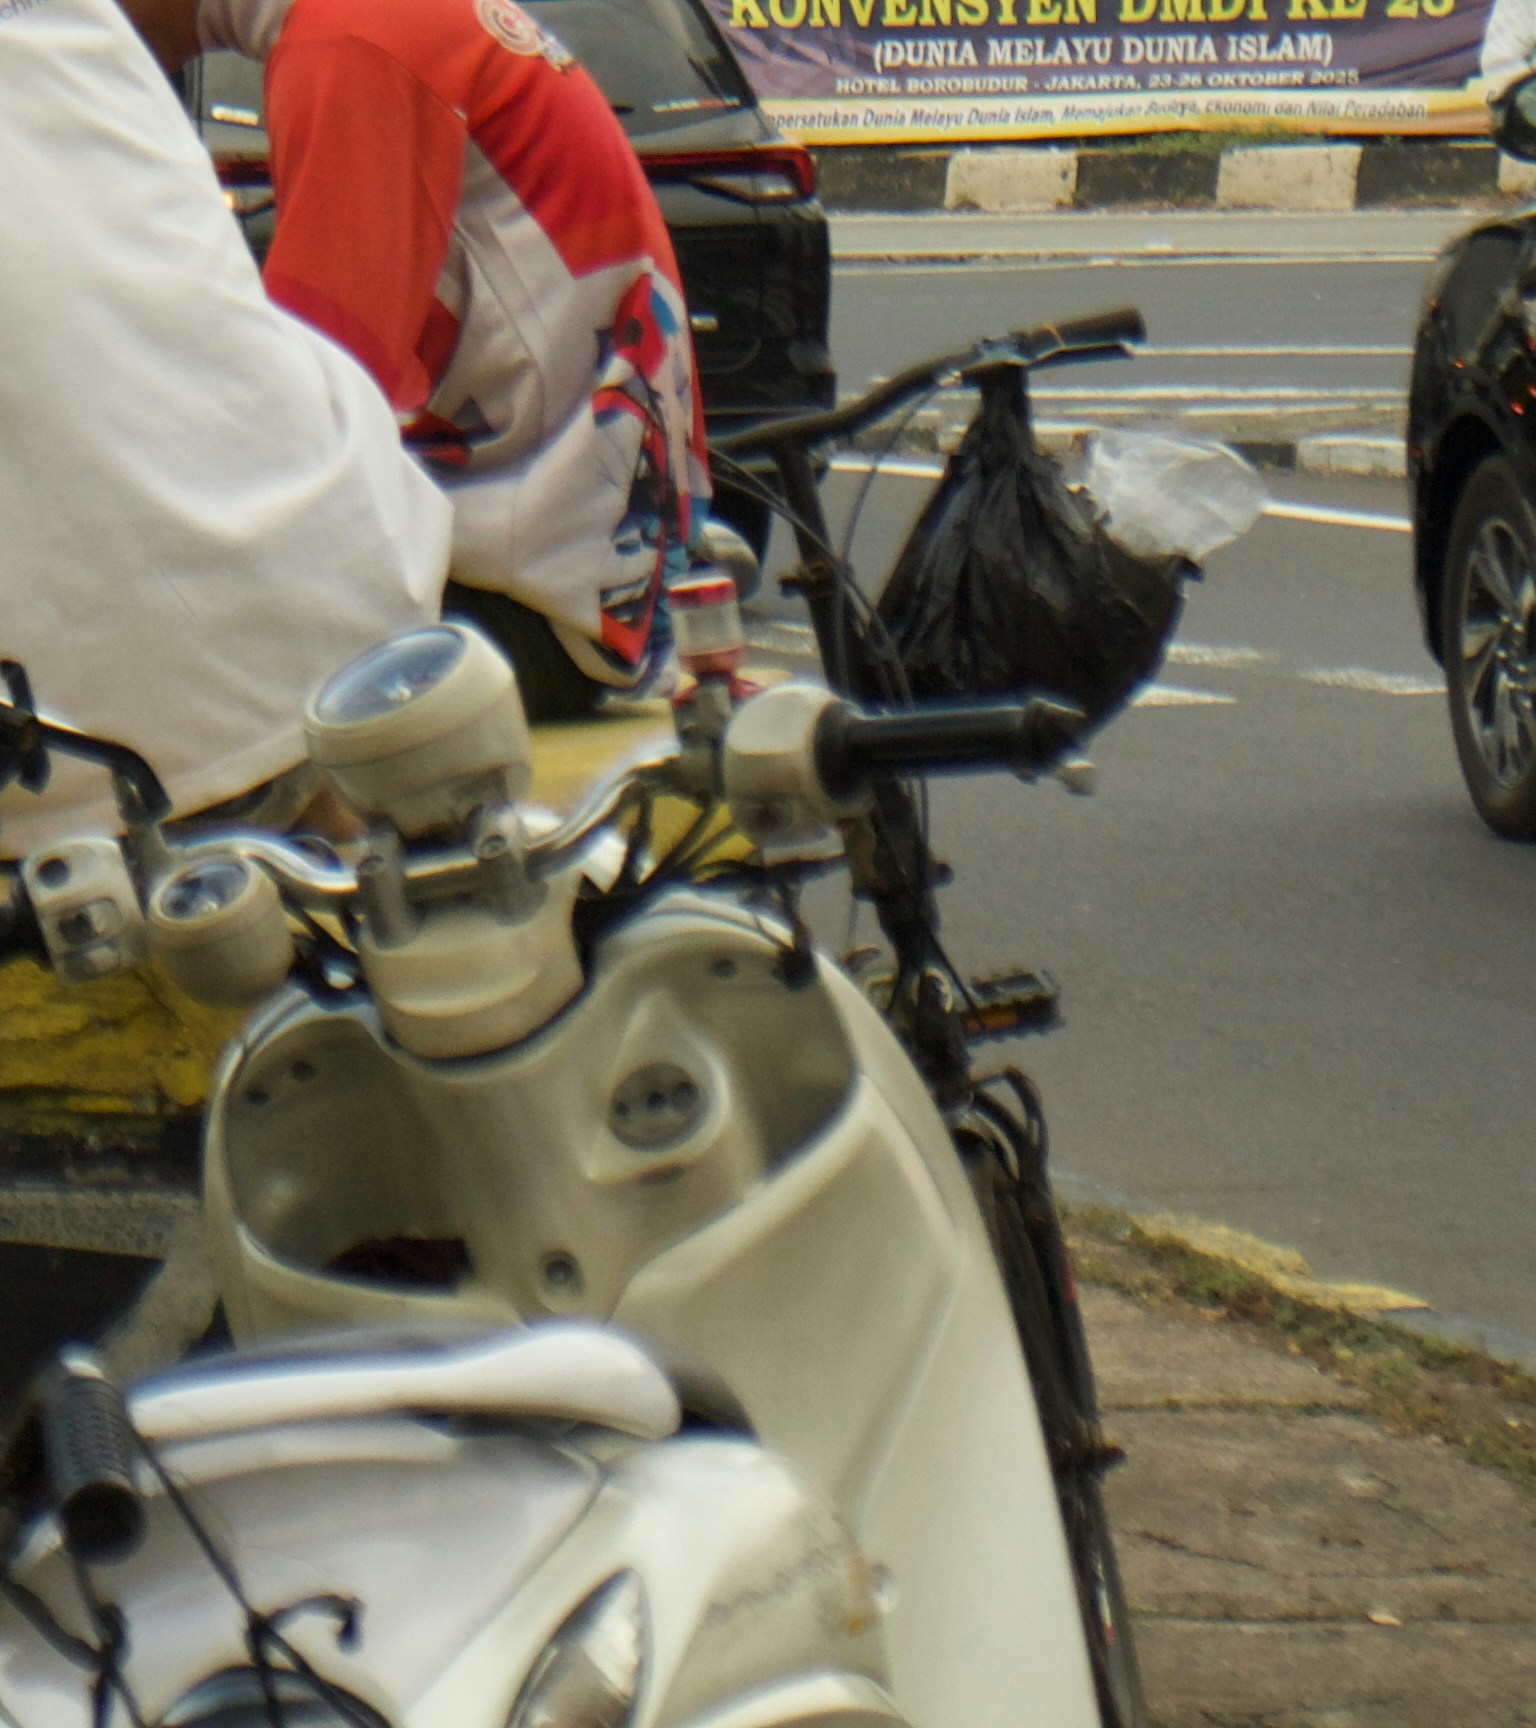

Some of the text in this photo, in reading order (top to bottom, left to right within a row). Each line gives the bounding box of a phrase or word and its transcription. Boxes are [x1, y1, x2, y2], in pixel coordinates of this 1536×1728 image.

[872, 31, 1334, 74] (DUNIA MELAYU DUNIA ISLAM)
[835, 77, 902, 95] HOTEL
[906, 75, 1029, 93] BOROBUDUR
[1206, 69, 1306, 88] OKTOBER
